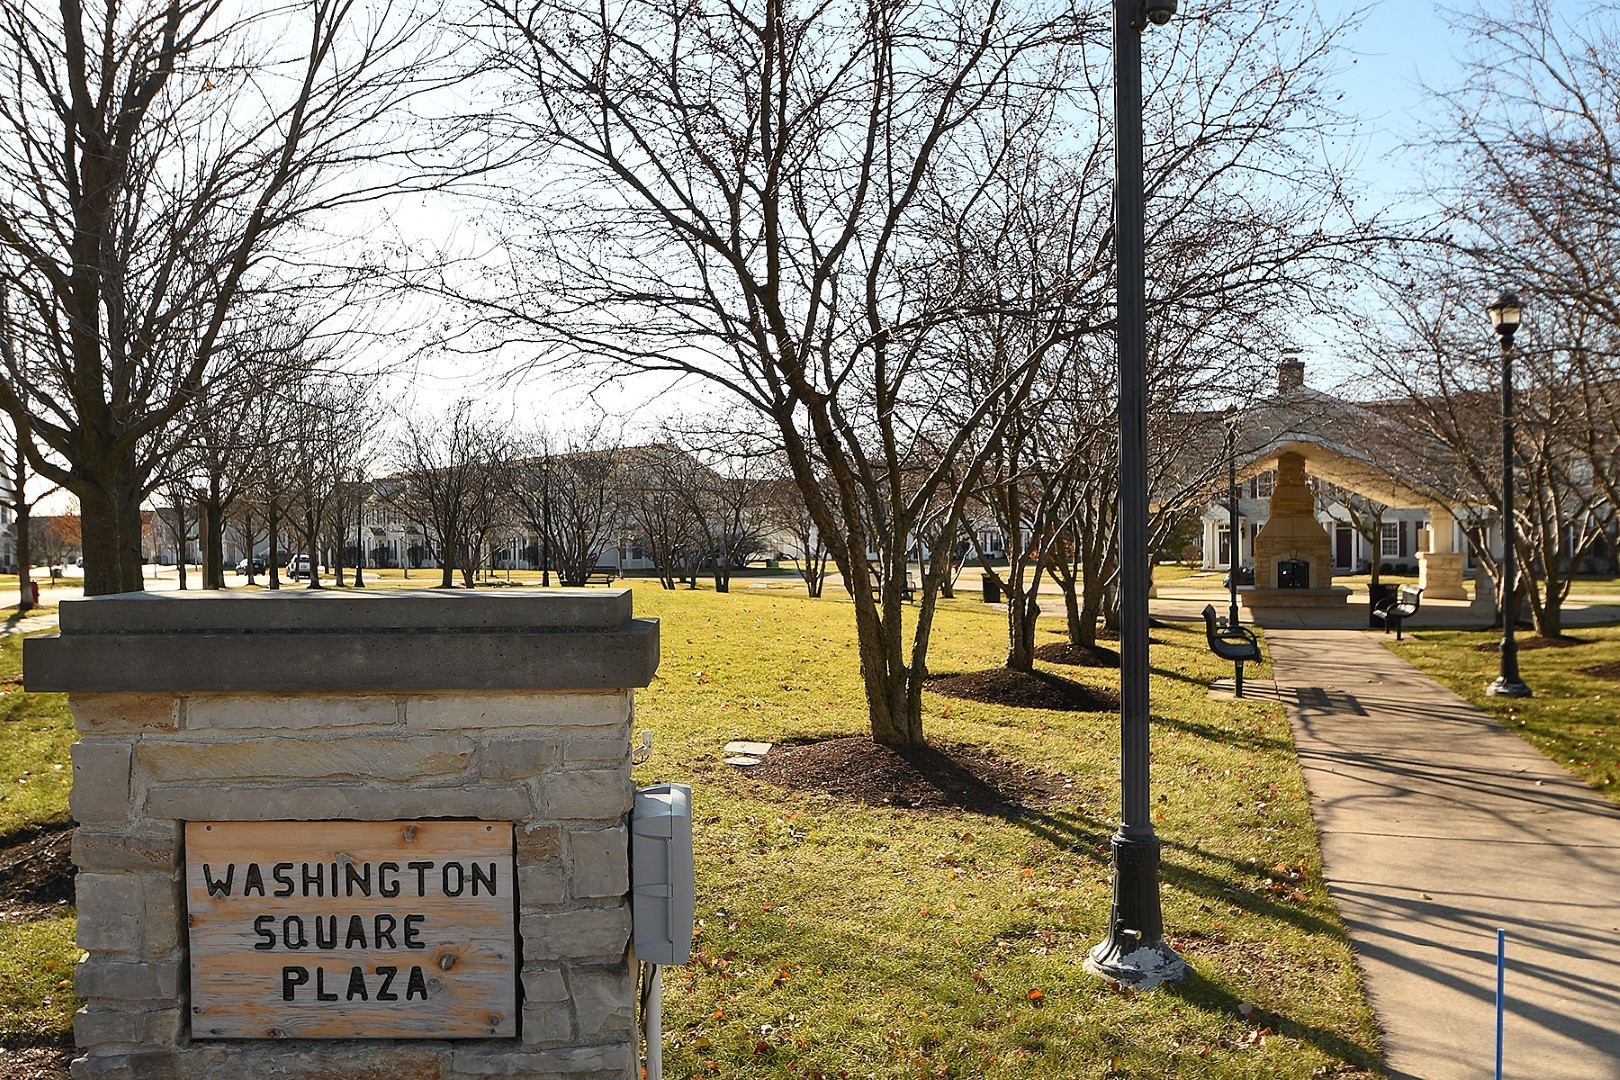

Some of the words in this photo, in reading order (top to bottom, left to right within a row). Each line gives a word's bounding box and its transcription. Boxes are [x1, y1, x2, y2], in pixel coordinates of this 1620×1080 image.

[203, 861, 498, 898] WASHINGTON
[254, 914, 426, 950] SQUARE
[282, 966, 428, 1001] PLAZA
